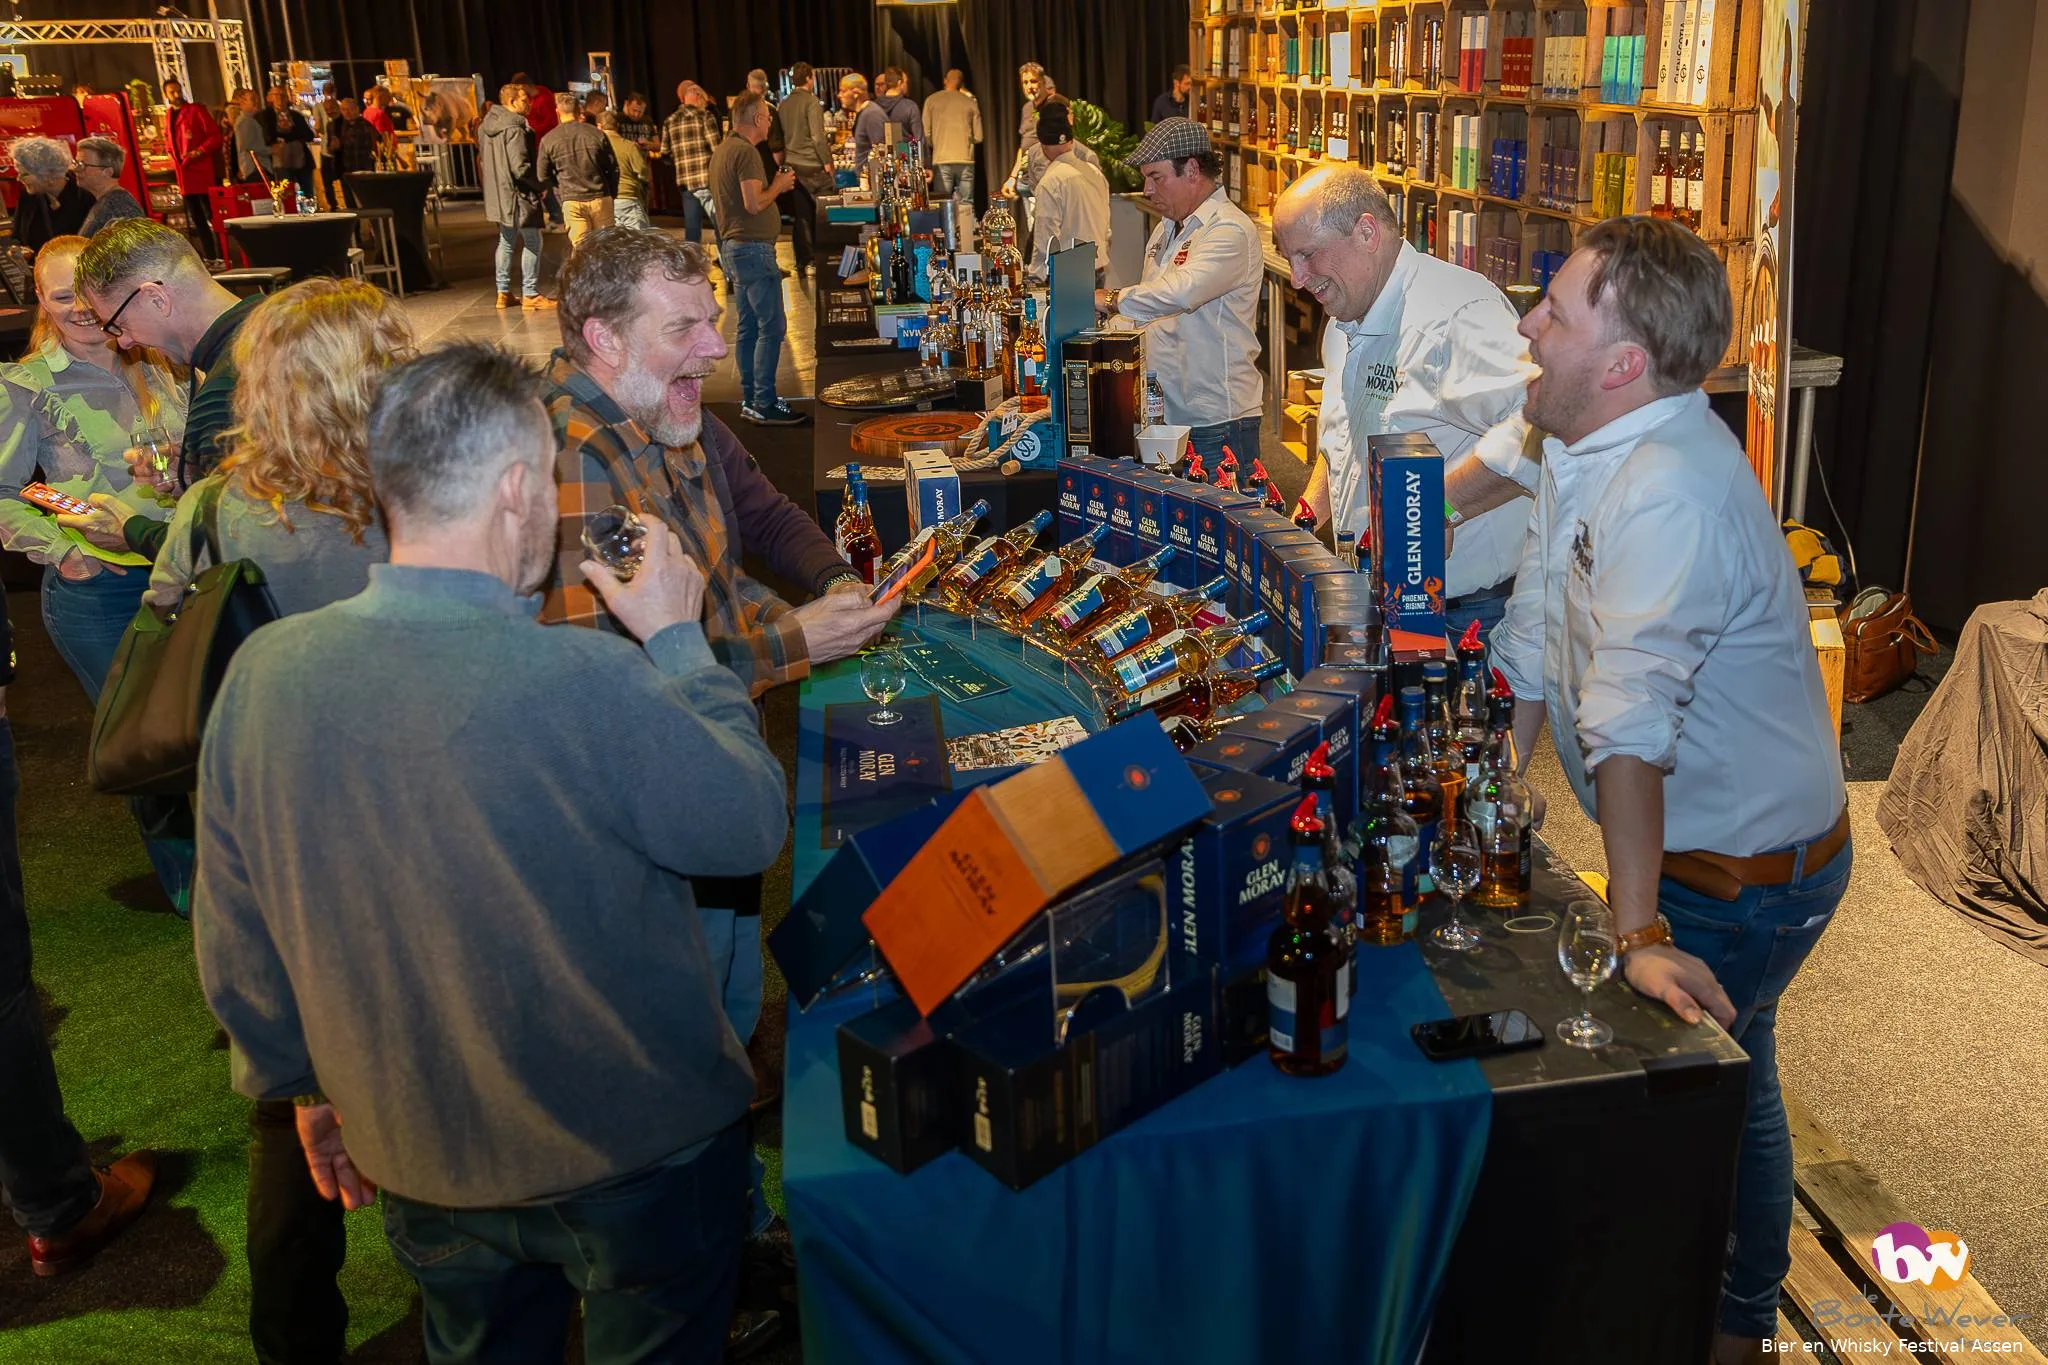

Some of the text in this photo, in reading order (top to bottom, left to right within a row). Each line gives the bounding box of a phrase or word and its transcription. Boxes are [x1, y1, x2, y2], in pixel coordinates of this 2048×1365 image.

[1374, 363, 1398, 379] GLEN
[1365, 376, 1403, 393] MORAY
[1062, 492, 1077, 502] GLEN
[936, 488, 945, 521] MORAY
[1060, 499, 1080, 510] MORAY
[1090, 500, 1104, 510] GLEN
[1087, 506, 1107, 518] MORAY
[1114, 508, 1129, 519] GLEN
[1111, 514, 1132, 527] MORAY
[1142, 516, 1157, 528] GLEN
[1406, 470, 1422, 585] GLEN MORAY
[1138, 523, 1160, 537] MORAY
[1173, 524, 1188, 536] GLEN
[1170, 531, 1192, 545] MORAY
[1200, 533, 1215, 546] GLEN
[1197, 540, 1218, 556] MORAY
[1402, 594, 1428, 602] PHOENIX
[1405, 602, 1425, 610] RISING
[859, 750, 876, 782] MORAY
[878, 753, 895, 776] GLEN
[1181, 837, 1196, 907] MORA
[1246, 859, 1279, 886] GLEN
[1238, 869, 1286, 905] MORAY
